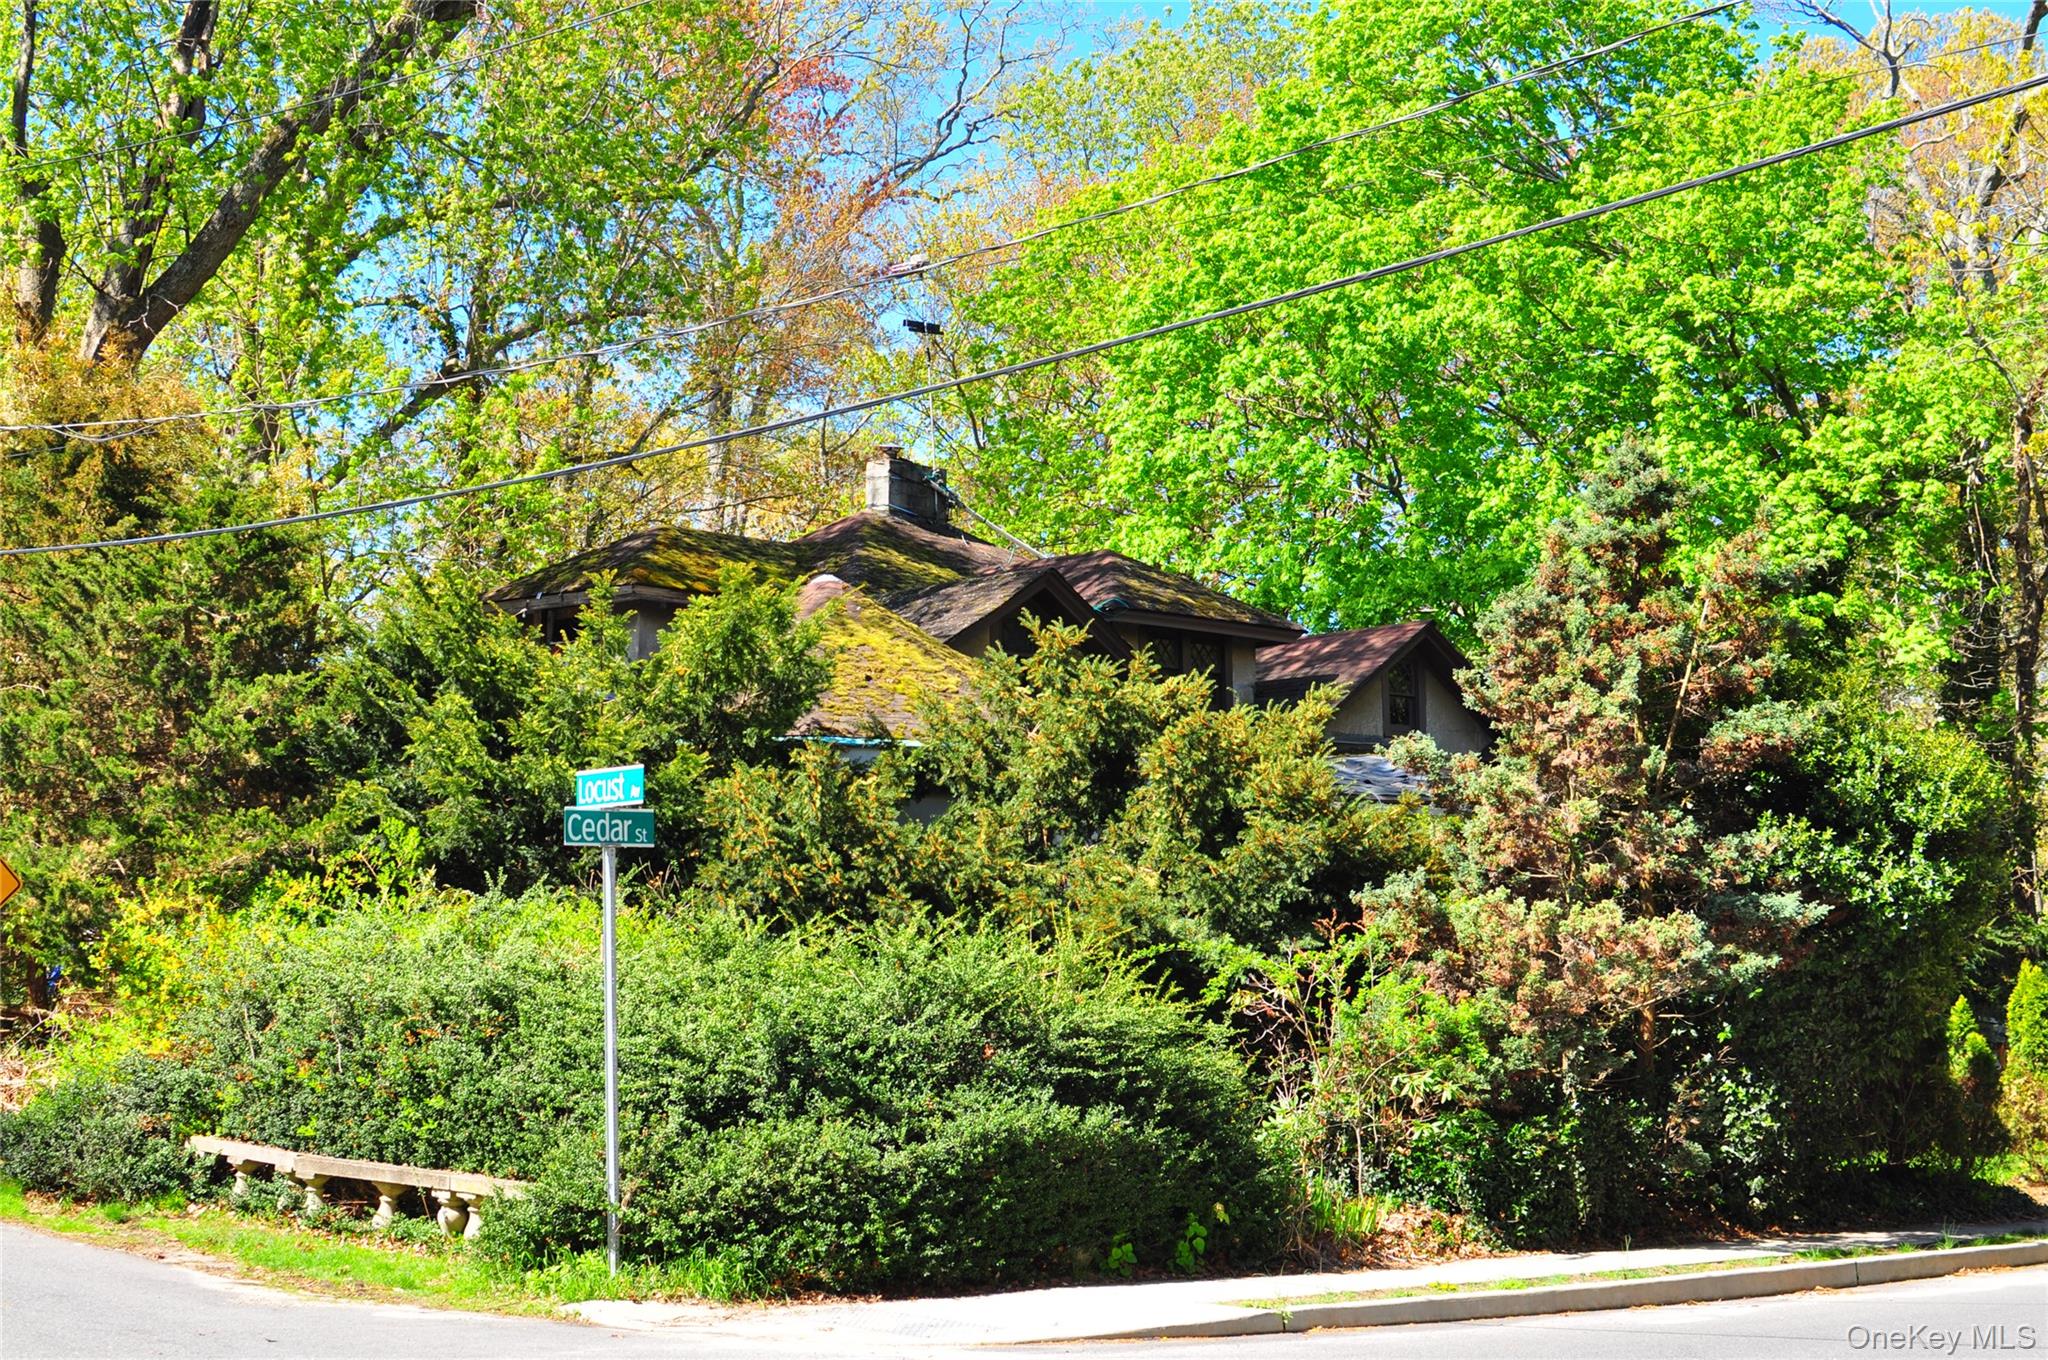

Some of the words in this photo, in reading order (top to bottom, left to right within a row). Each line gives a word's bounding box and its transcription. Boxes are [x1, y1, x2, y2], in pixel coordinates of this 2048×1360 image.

[578, 773, 624, 804] Locust
[567, 812, 632, 842] Cedar
[635, 828, 647, 842] St
